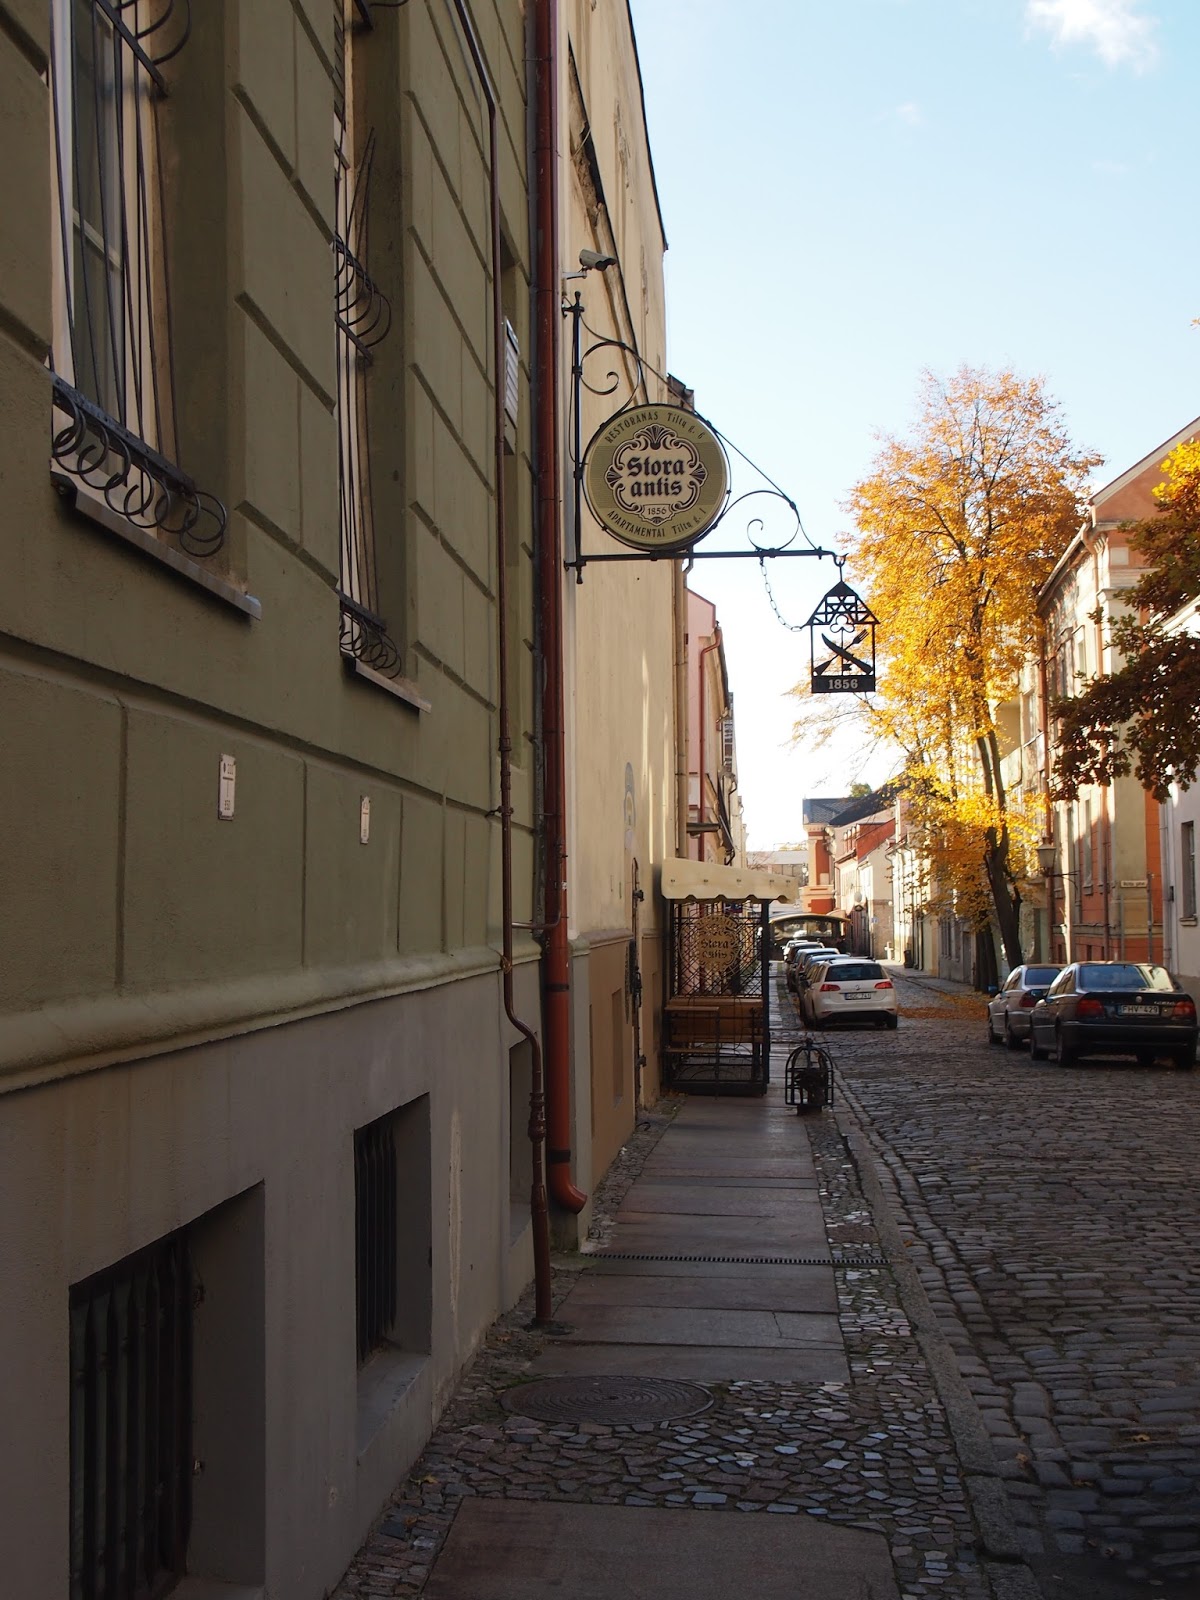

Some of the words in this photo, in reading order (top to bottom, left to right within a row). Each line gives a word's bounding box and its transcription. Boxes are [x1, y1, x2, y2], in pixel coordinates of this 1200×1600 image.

[604, 411, 659, 444] RESTORANAS
[627, 456, 685, 477] Stora
[631, 477, 682, 497] antis
[647, 507, 667, 515] 1856
[607, 510, 666, 537] APARTAMENTAI
[828, 679, 858, 689] 1856
[1122, 1005, 1140, 1013] FHV
